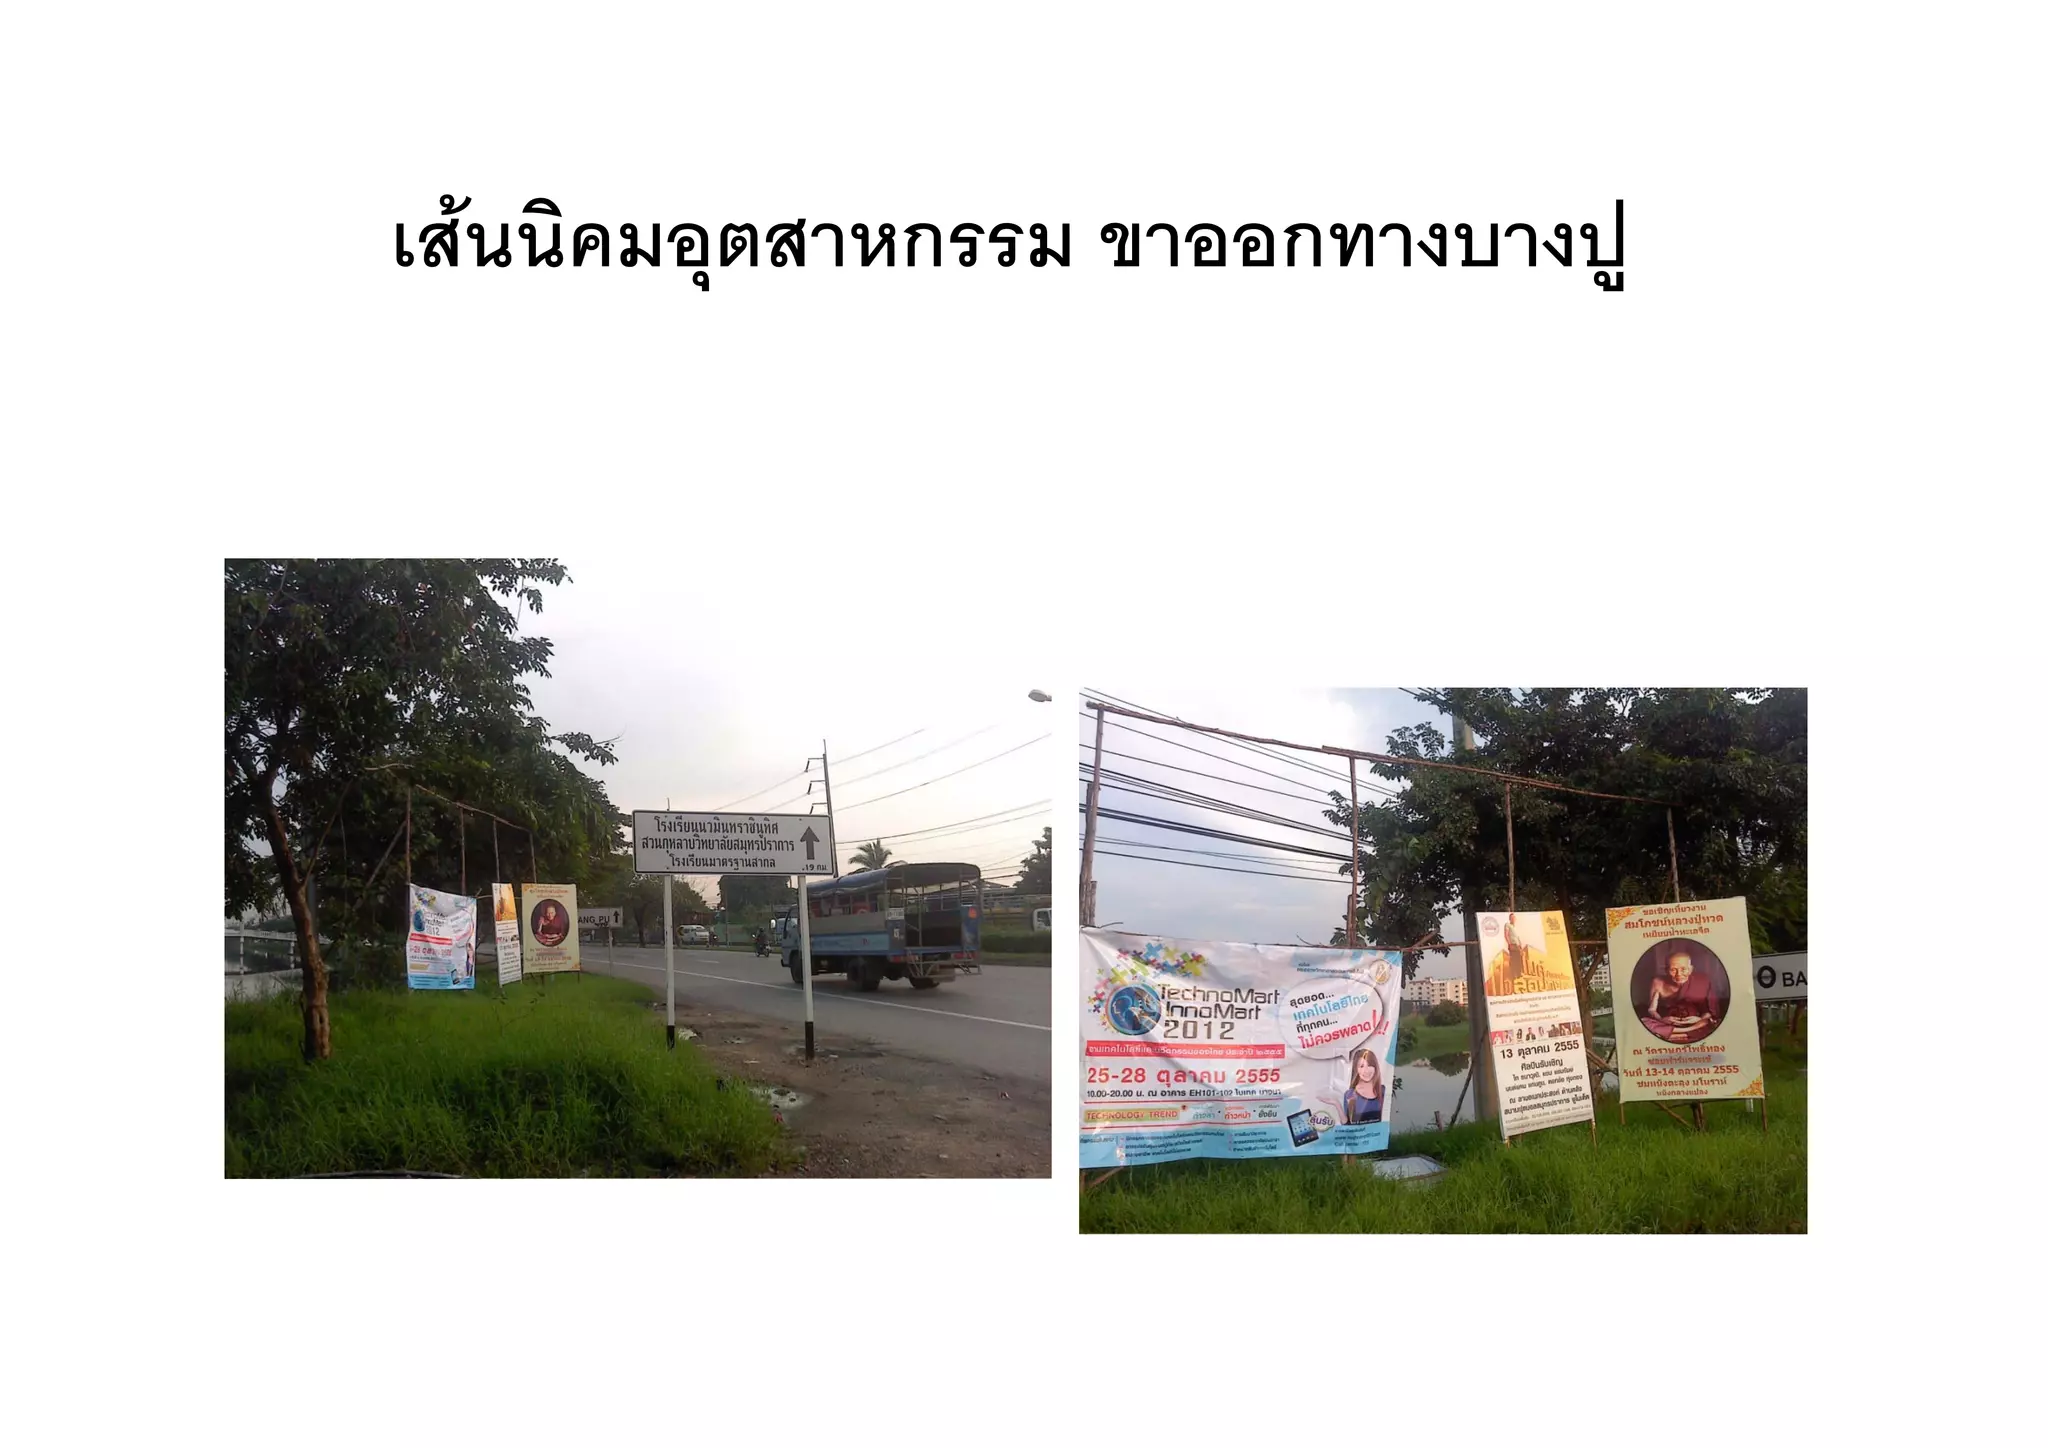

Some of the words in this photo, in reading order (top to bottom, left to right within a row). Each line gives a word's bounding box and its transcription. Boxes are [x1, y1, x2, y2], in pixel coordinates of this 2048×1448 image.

[654, 815, 779, 839] โรงเรียนนวมินทราชินูทิศ
[641, 834, 795, 854] สวนกุหลาบวิทยาลัยสมุทรปราการ
[669, 853, 776, 870] โรงเรียนมาตรฐานสากล
[598, 915, 610, 924] PU
[1158, 985, 1280, 1004] TechnoMart
[1289, 992, 1335, 1009] สุดยอด...
[1165, 1001, 1262, 1020] InnoMart
[1292, 994, 1369, 1021] เทคโนโลยีไทย
[1163, 1019, 1235, 1040] 2012
[1499, 1048, 1513, 1059] 13
[1517, 1044, 1550, 1059] ตุลาคม
[1553, 1040, 1580, 1053] 2555
[1087, 1067, 1146, 1084] 25-28
[1156, 1068, 1226, 1088] ตุลาคม
[1235, 1067, 1281, 1084] 2555
[1623, 1066, 1643, 1077] วันที่
[1645, 1067, 1675, 1077] 13-14
[1712, 1064, 1740, 1075] 2555
[1086, 1090, 1133, 1098] 10.00-20.00
[1160, 1089, 1186, 1097] อาคาร
[1189, 1089, 1233, 1097] EH101-102
[1086, 1110, 1144, 1121] TECHNOLOGY
[1149, 1109, 1178, 1119] TREND
